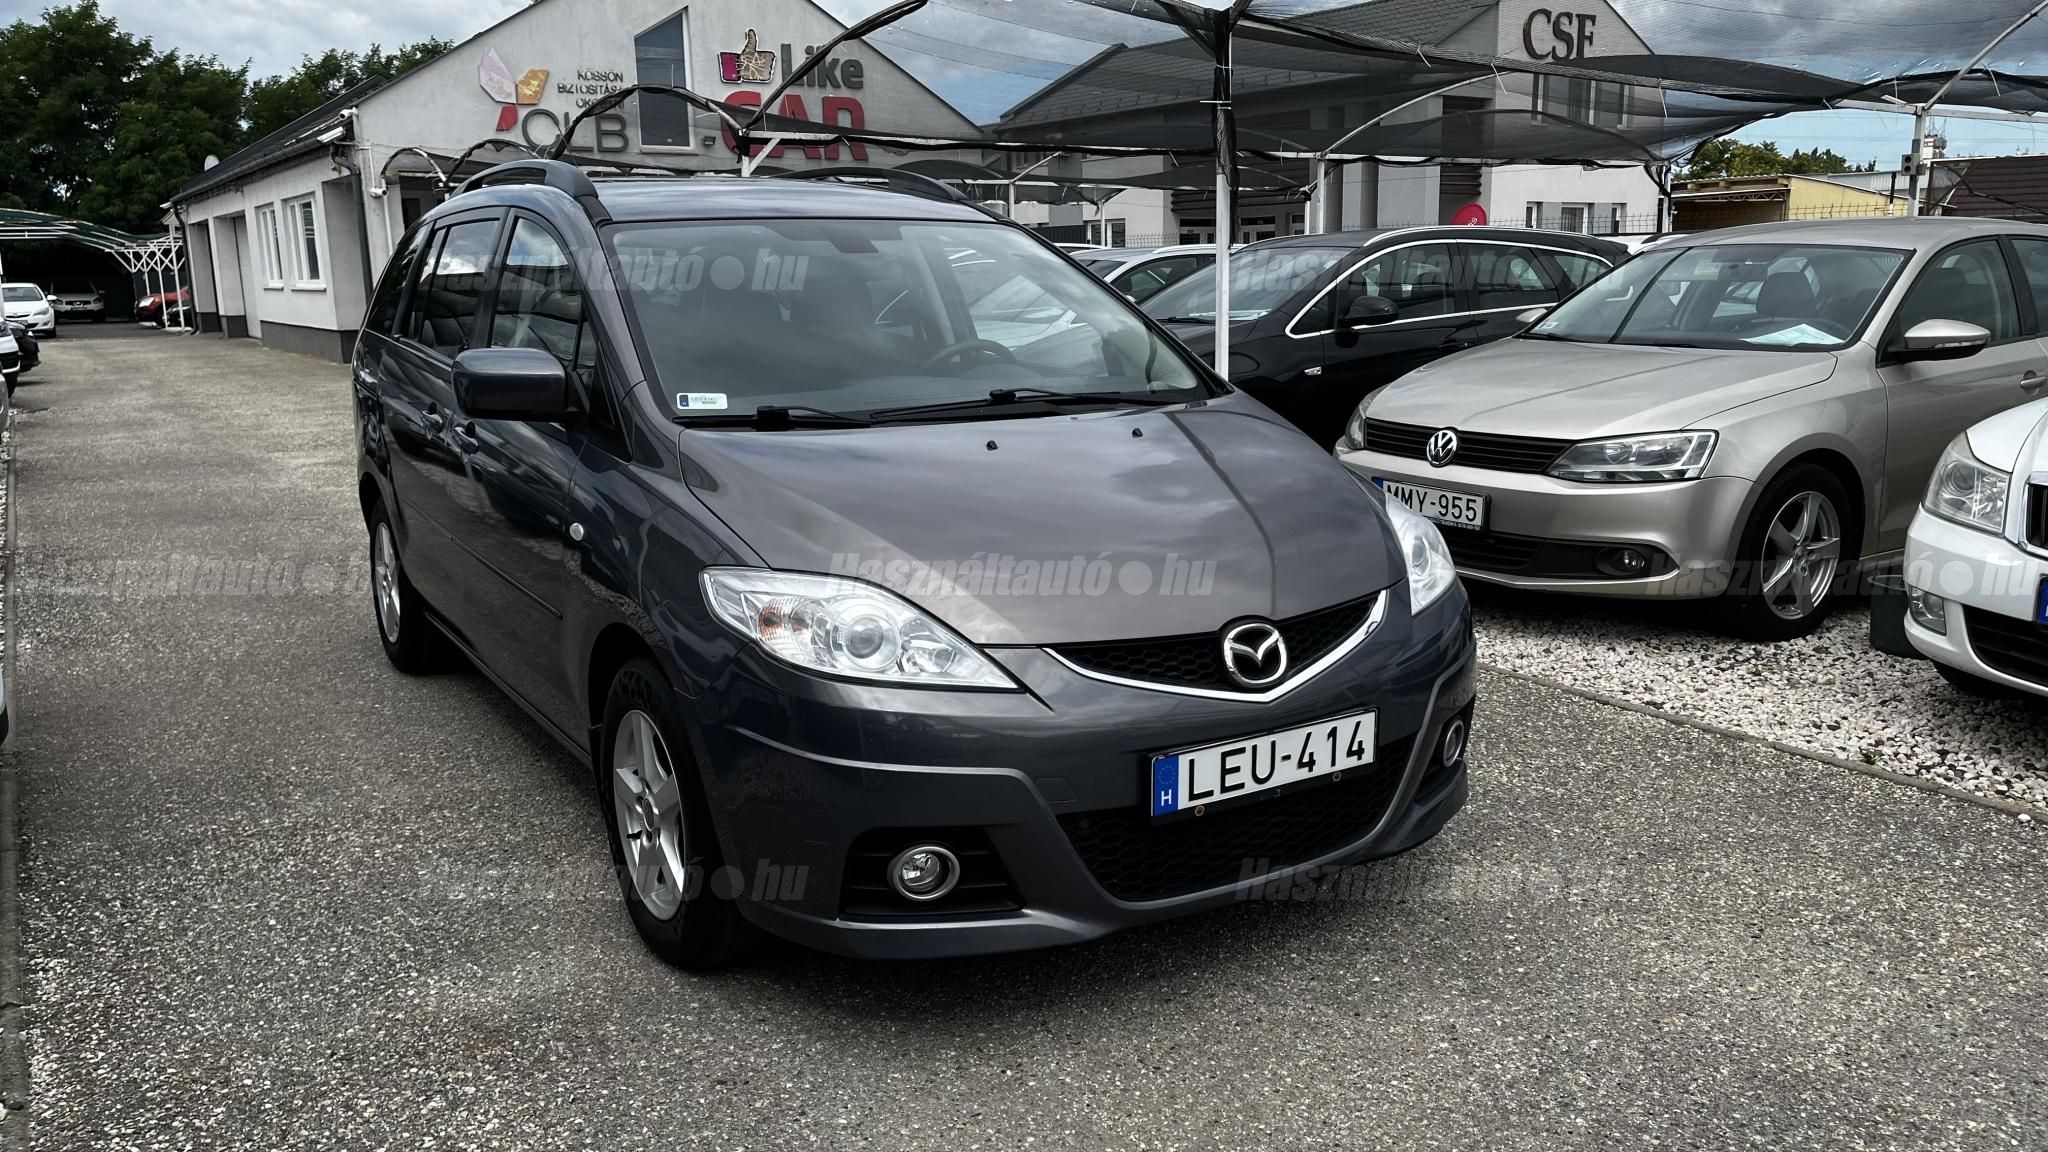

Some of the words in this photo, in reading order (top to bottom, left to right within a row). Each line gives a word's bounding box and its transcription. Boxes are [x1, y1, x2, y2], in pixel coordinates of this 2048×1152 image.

[1522, 8, 1597, 61] CSF
[780, 43, 864, 89] Like
[720, 90, 869, 161] CAR
[1187, 720, 1366, 803] LEU-414
[1160, 789, 1173, 807] H
